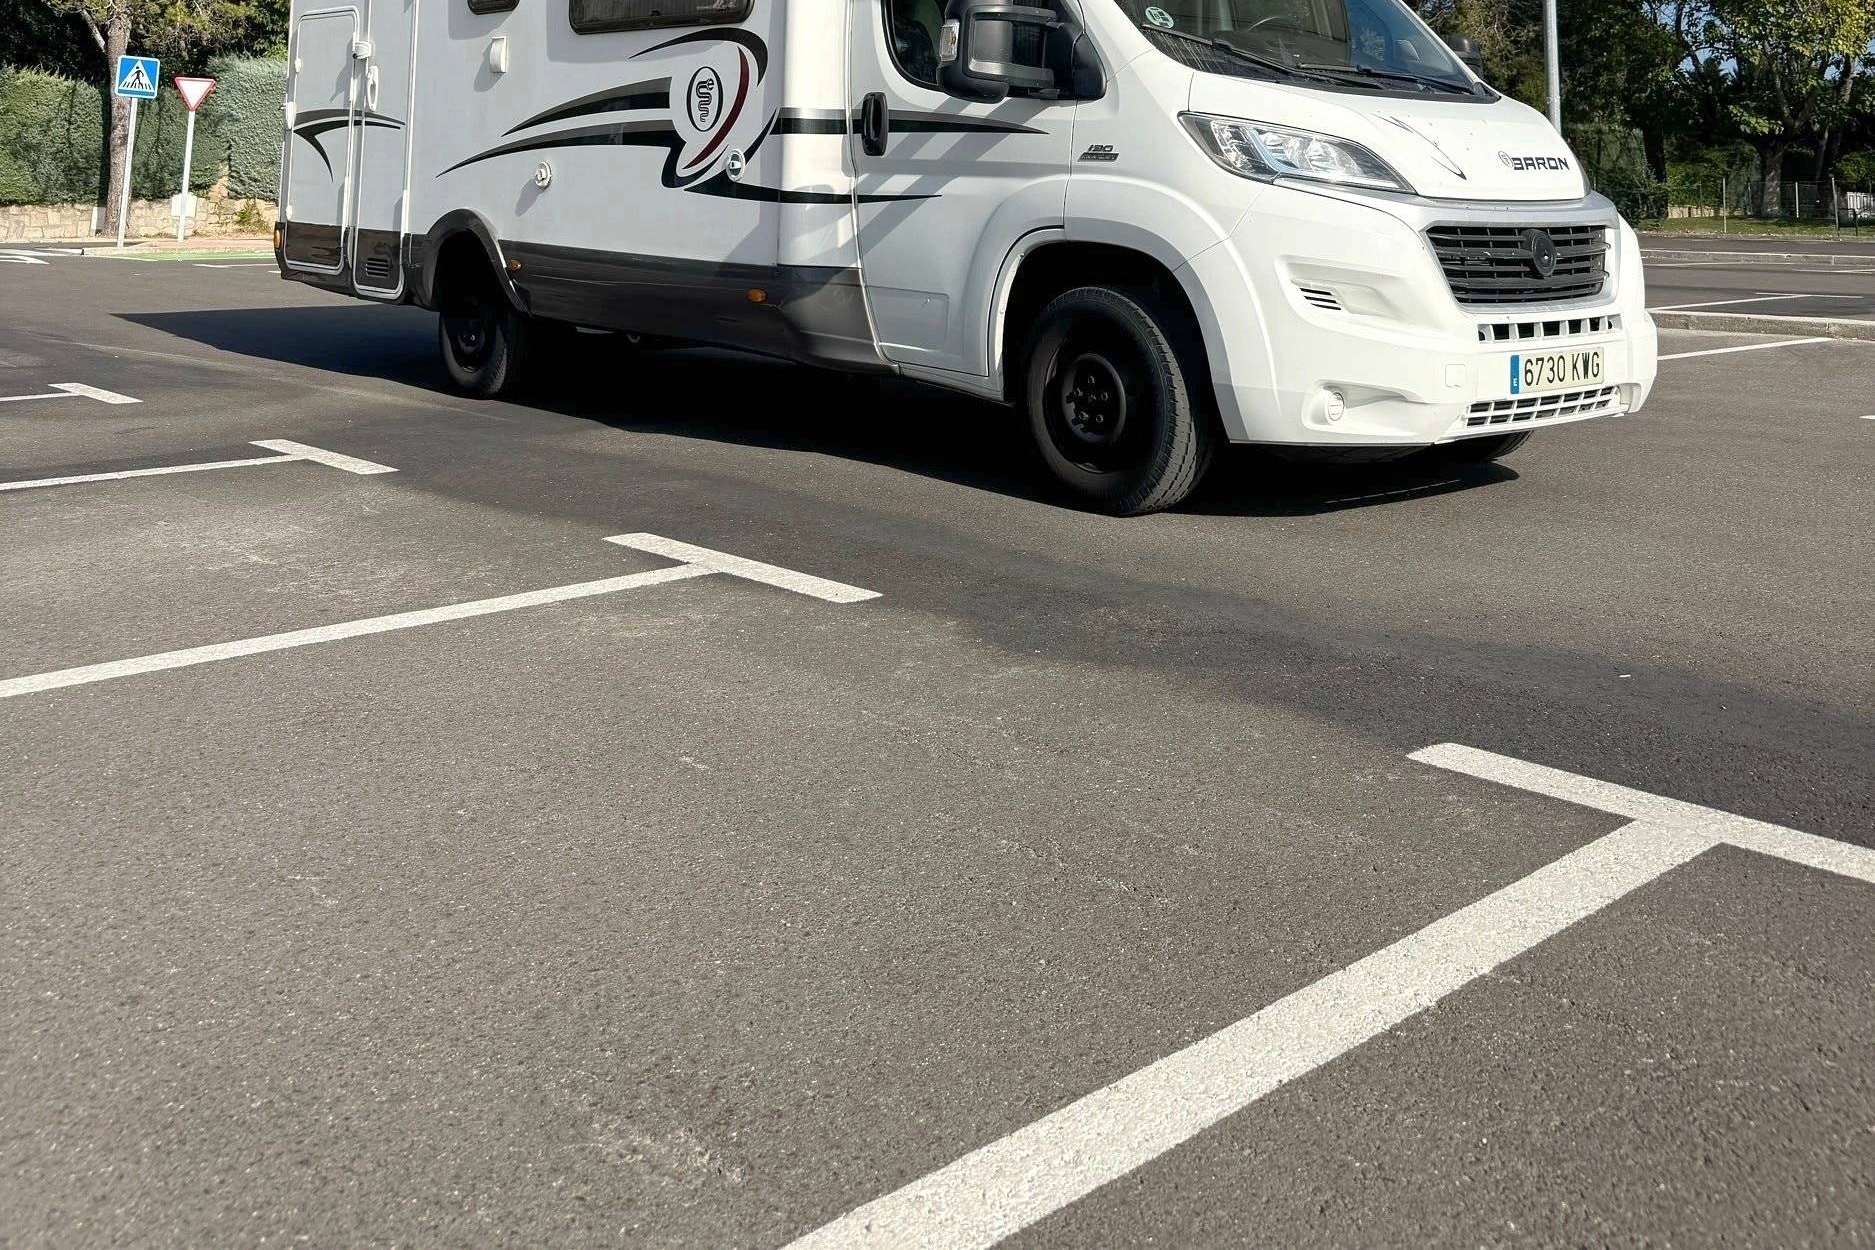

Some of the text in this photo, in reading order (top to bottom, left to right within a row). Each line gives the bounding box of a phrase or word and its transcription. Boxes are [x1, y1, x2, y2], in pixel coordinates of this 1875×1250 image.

[1511, 157, 1570, 171] BARON
[1524, 355, 1566, 386] 6730
[1572, 351, 1600, 381] KWG
